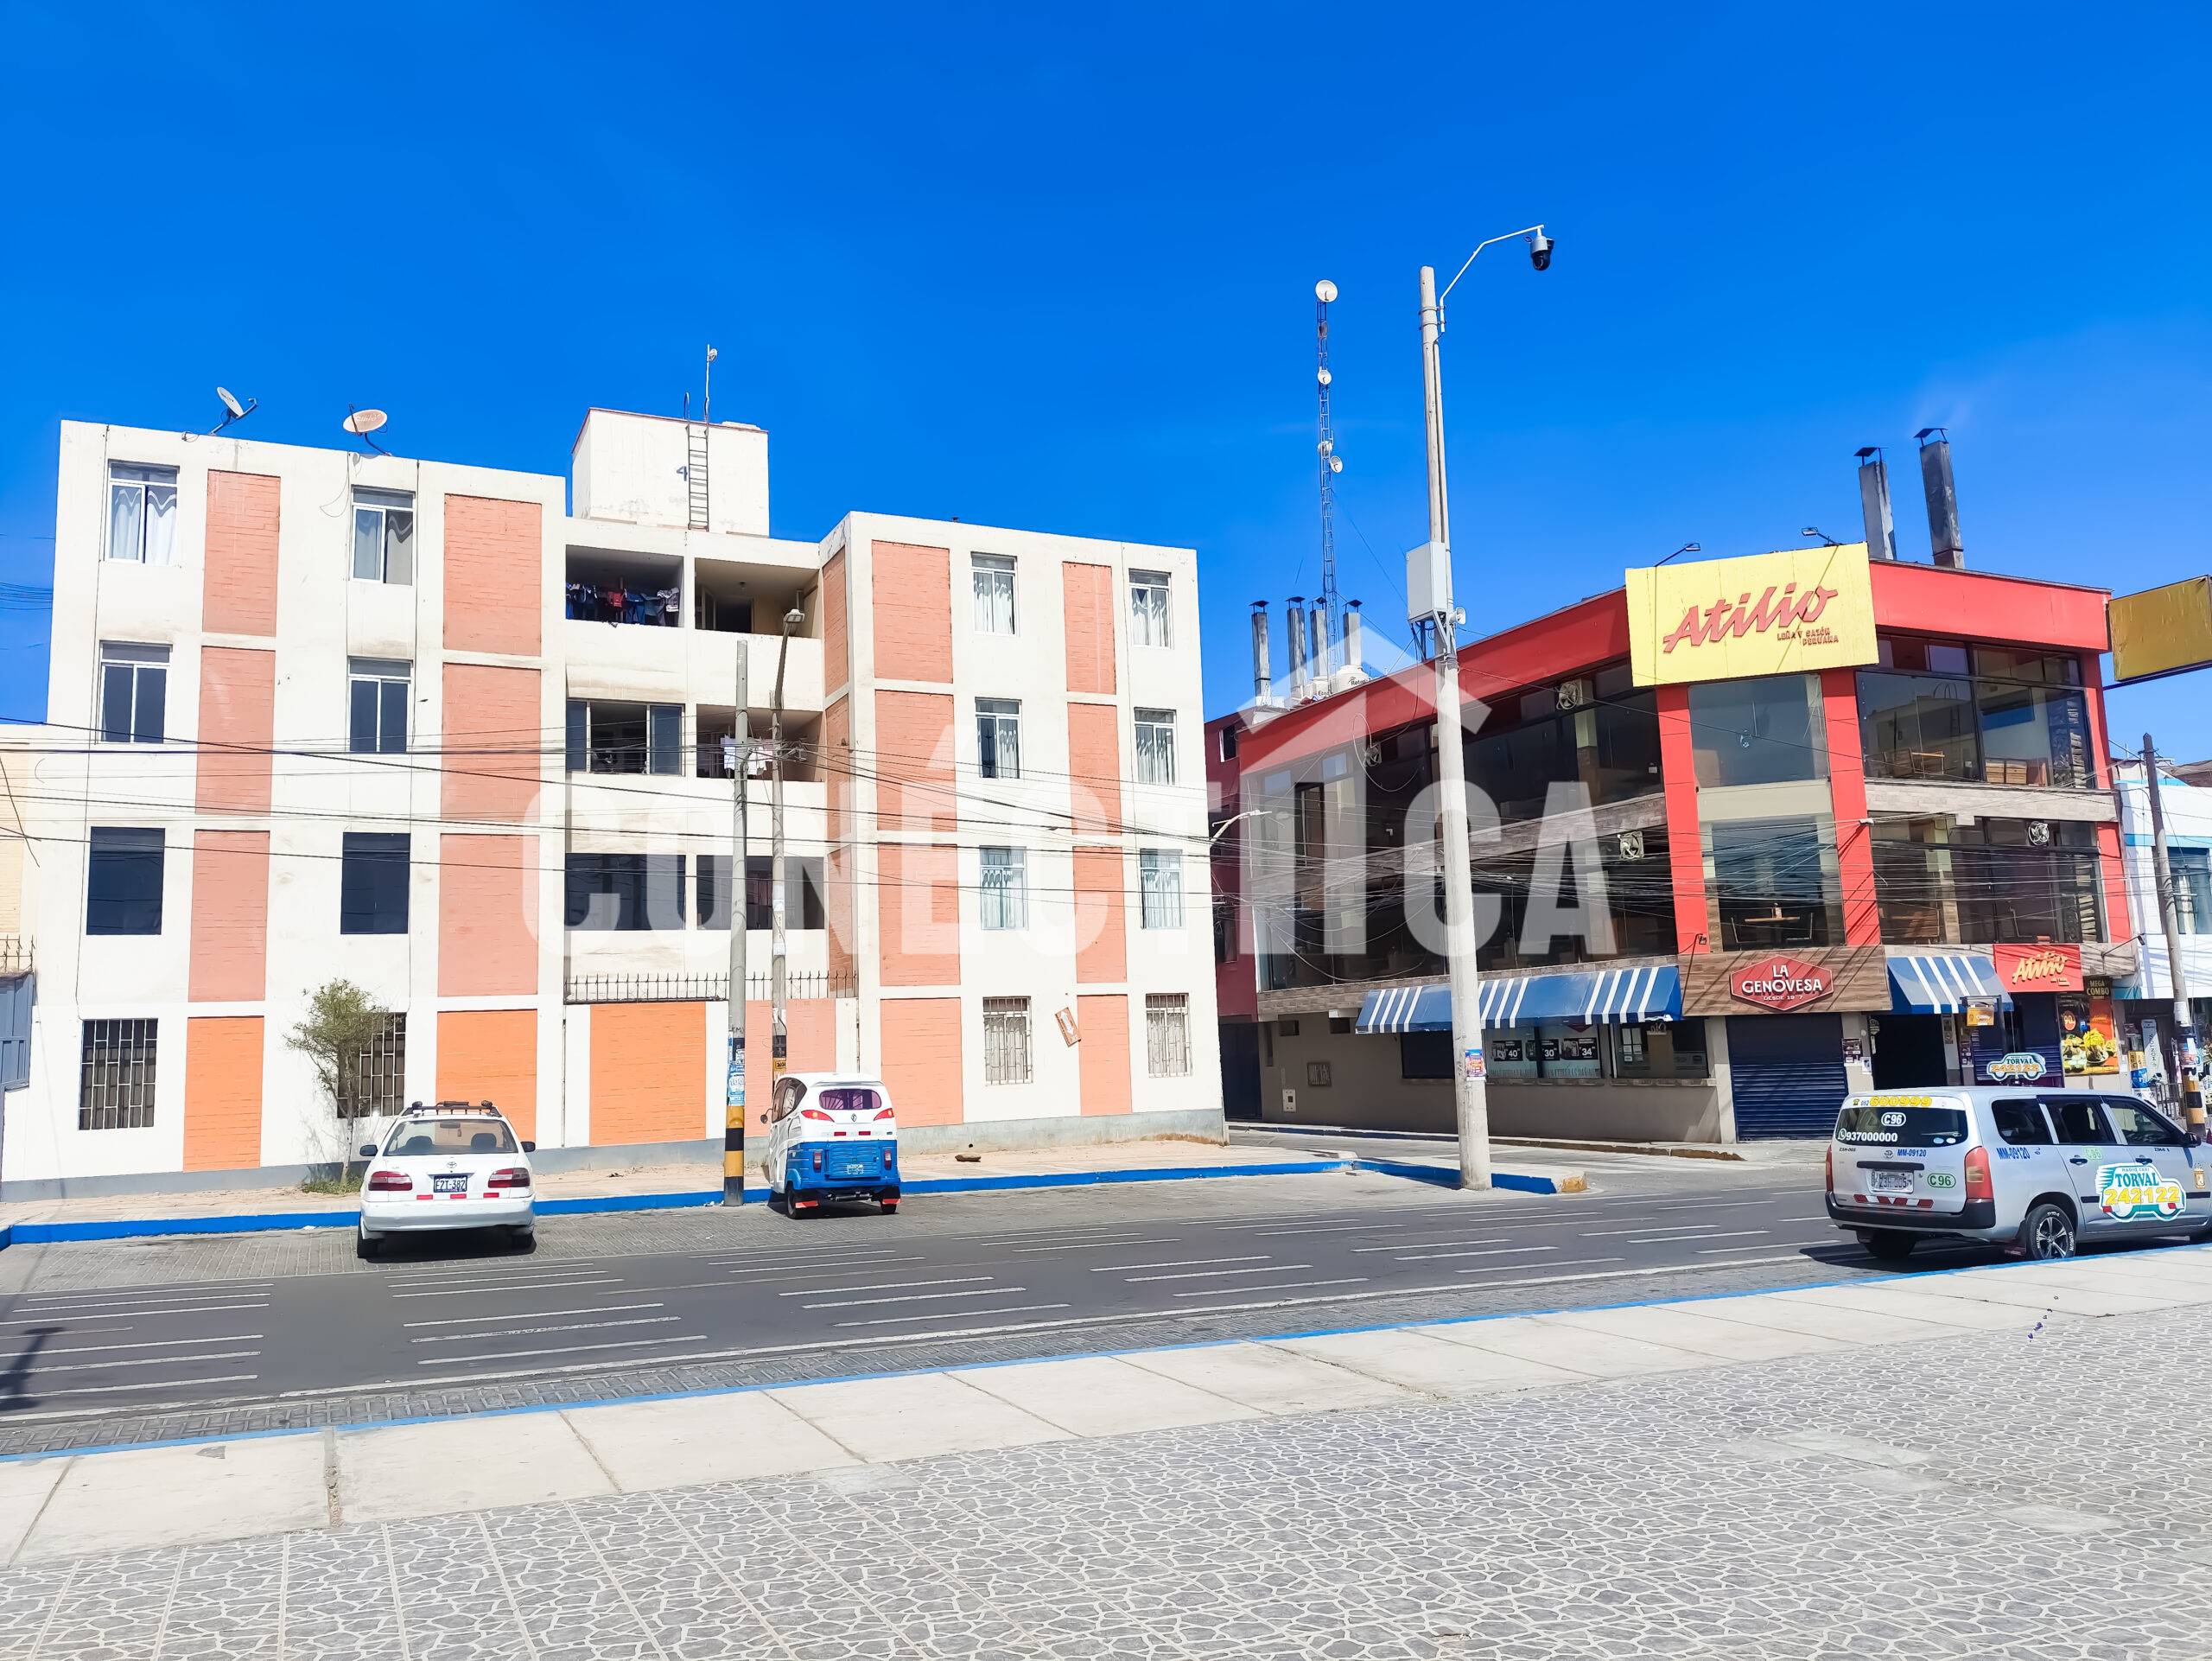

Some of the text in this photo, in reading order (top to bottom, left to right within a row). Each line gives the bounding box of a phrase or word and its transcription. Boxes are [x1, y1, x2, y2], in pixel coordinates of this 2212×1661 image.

[677, 466, 688, 481] 4
[1663, 582, 1839, 653] Atilio
[1802, 635, 1839, 646] PERUANA
[1772, 964, 1789, 977] LA
[1742, 978, 1822, 994] GENOVESA
[1870, 1096, 1932, 1107] 600999
[1884, 1114, 1903, 1124] C96
[1846, 1131, 1898, 1142] 937000000
[1897, 1149, 1927, 1157] MM-09120
[1996, 1147, 2031, 1159] MM-09120
[2115, 1172, 2159, 1187] TORVAL
[2105, 1186, 2180, 1205] 242122
